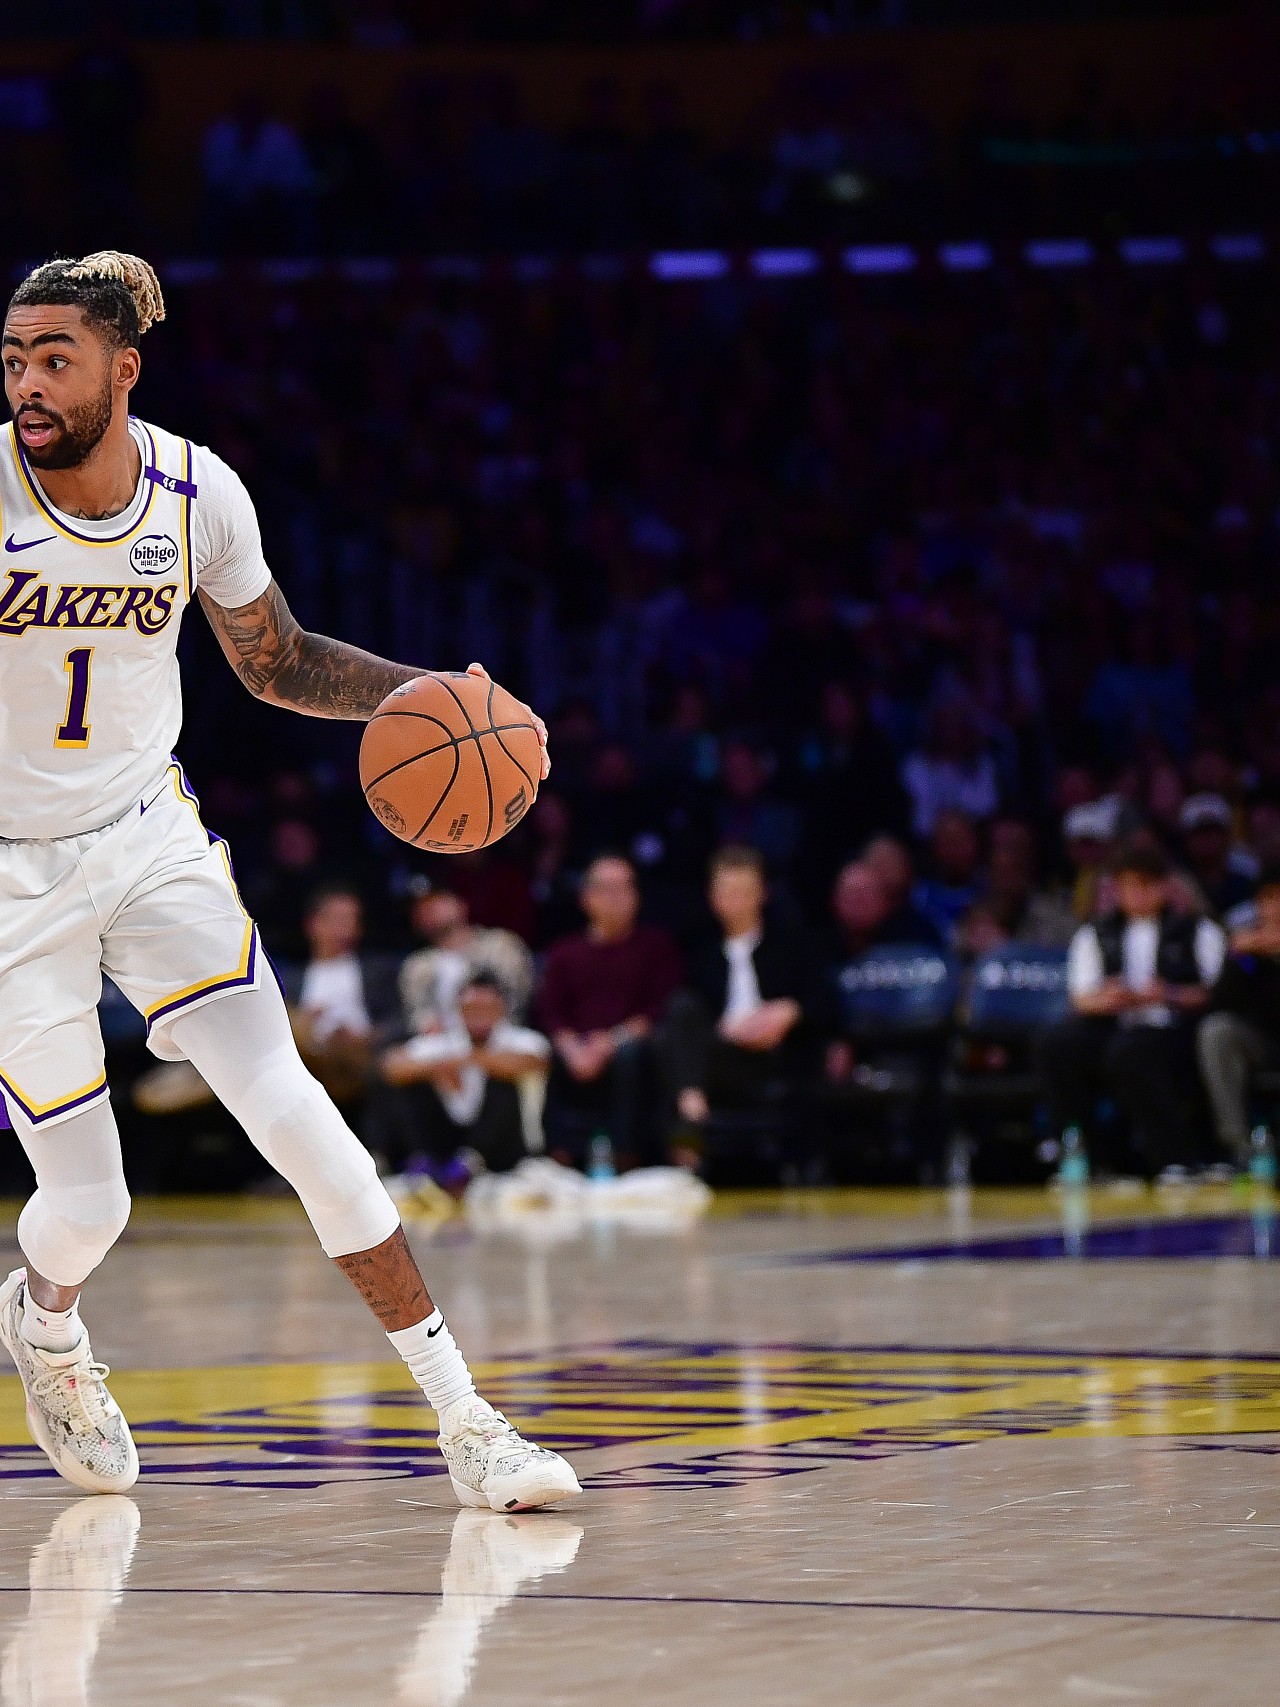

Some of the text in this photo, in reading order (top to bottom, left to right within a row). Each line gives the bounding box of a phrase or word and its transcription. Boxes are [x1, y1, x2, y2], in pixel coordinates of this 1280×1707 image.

[163, 477, 176, 490] 44
[134, 545, 175, 562] bibigo
[53, 647, 95, 748] 1
